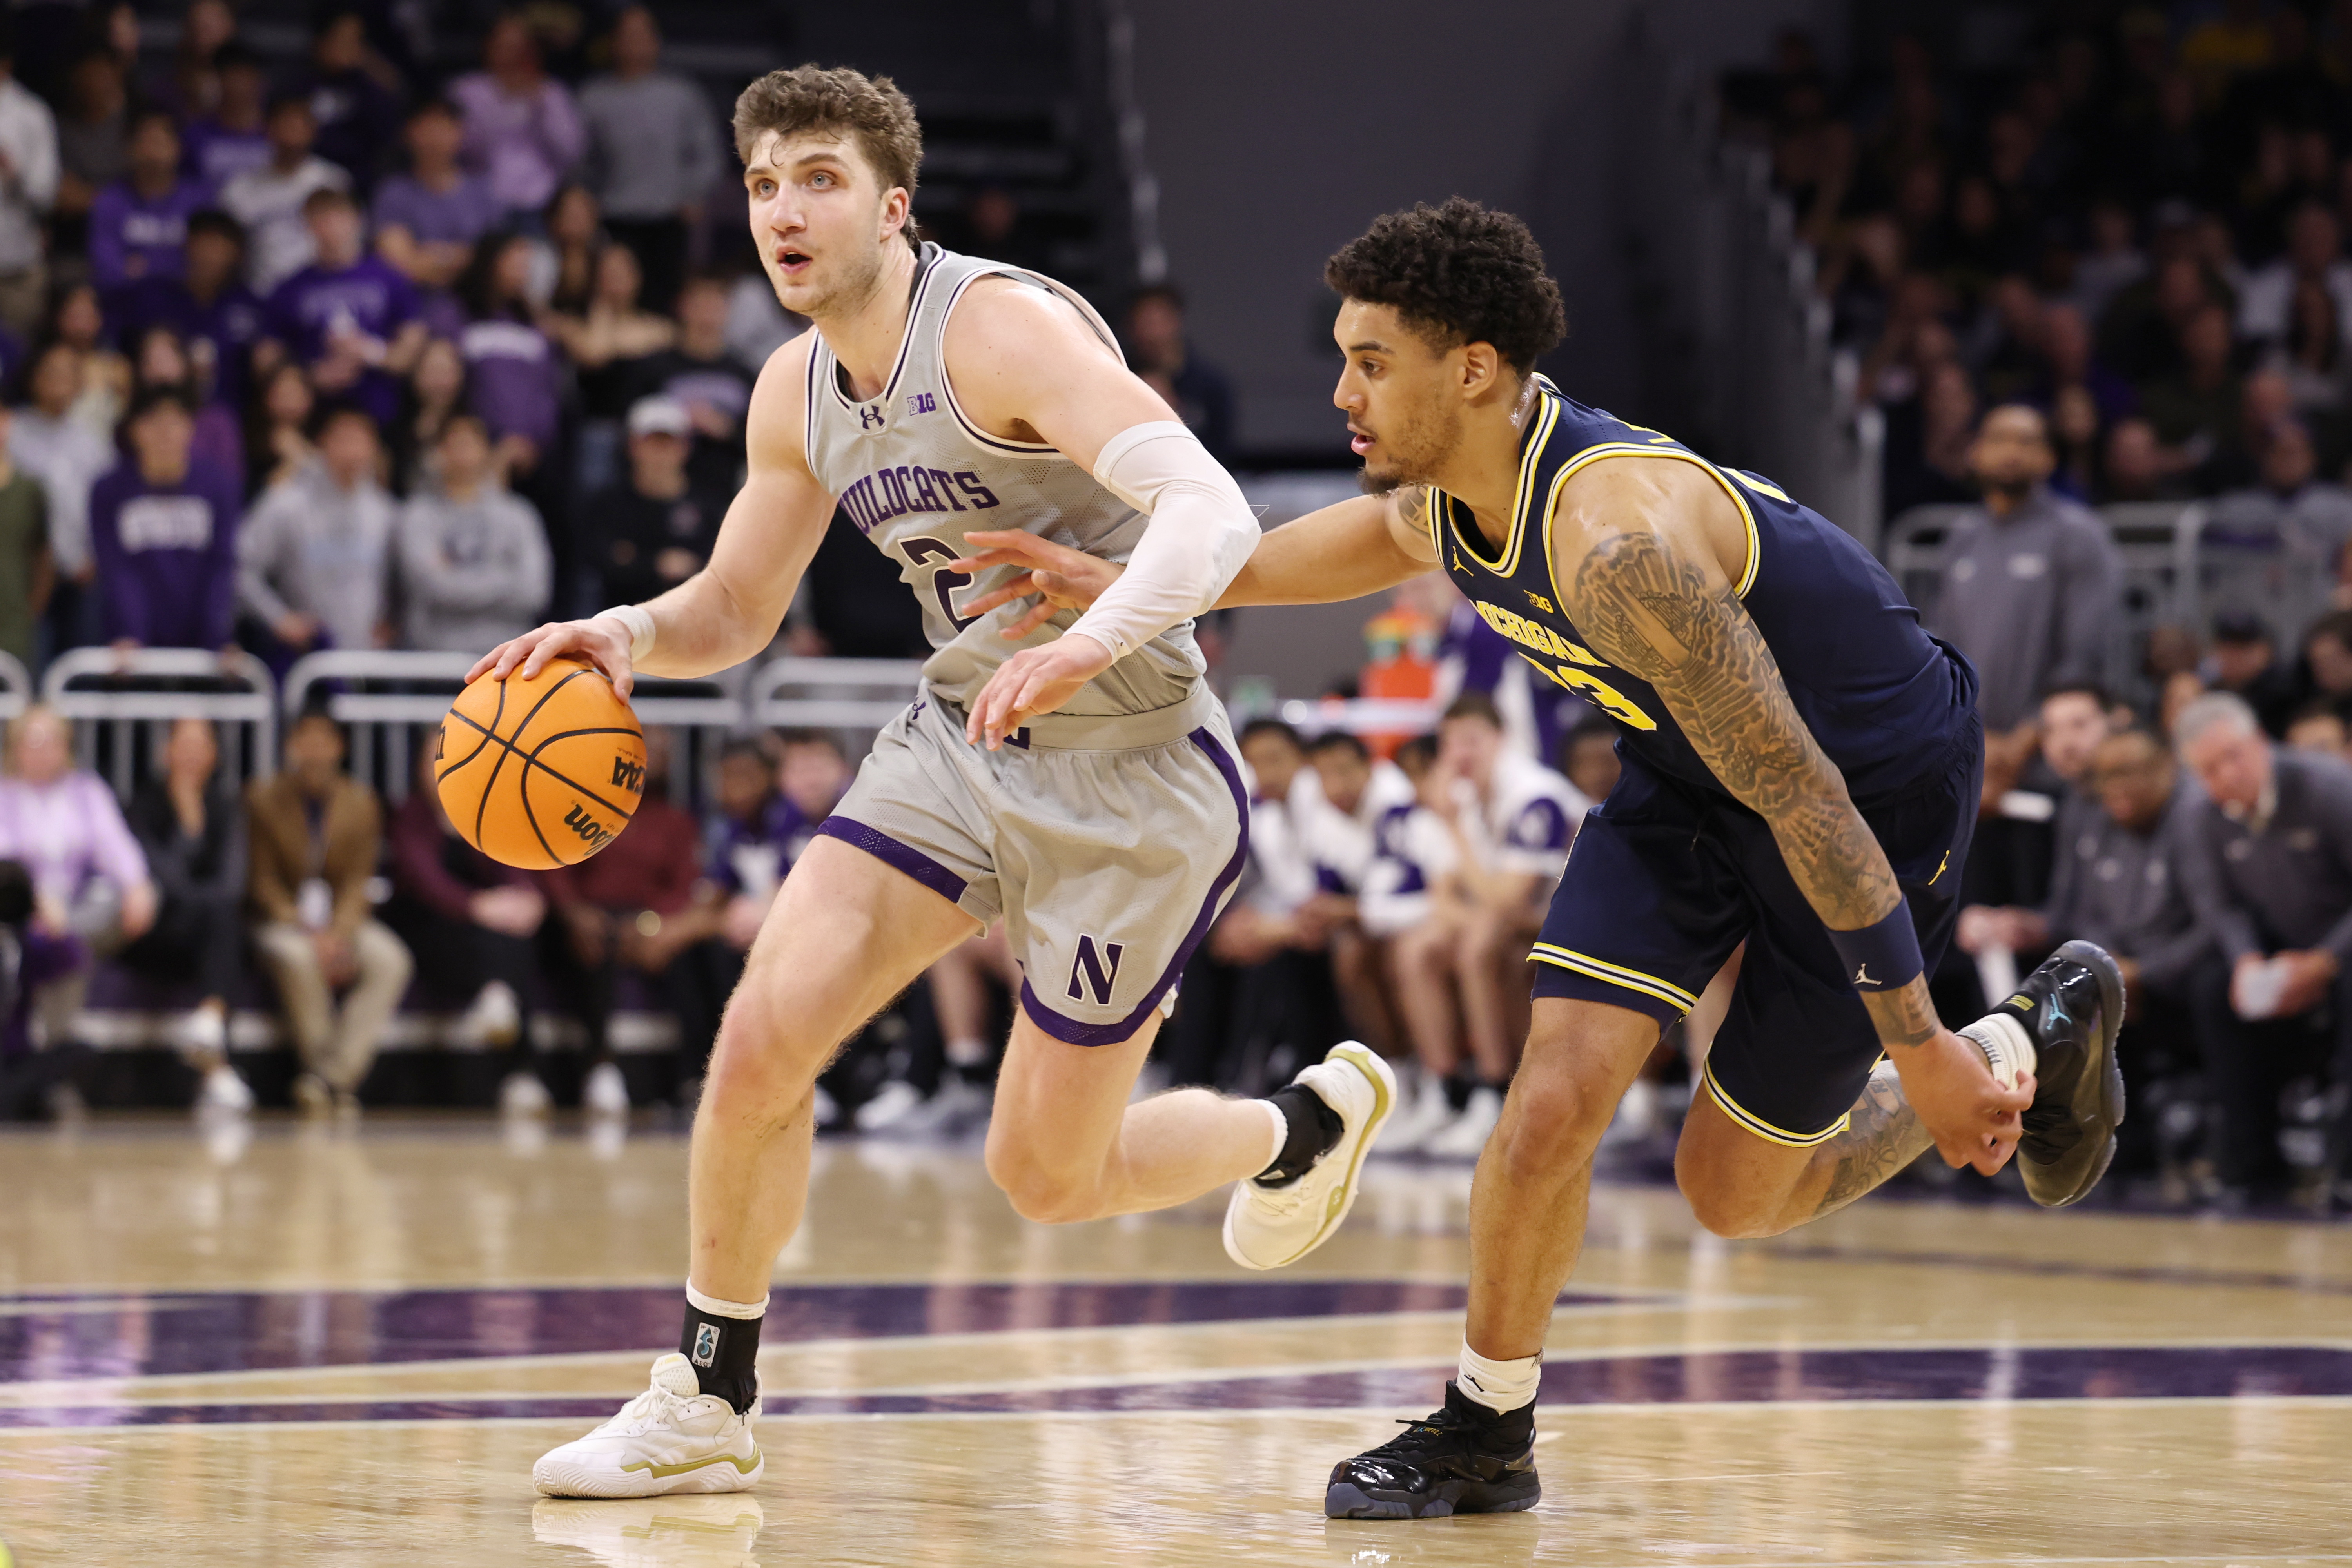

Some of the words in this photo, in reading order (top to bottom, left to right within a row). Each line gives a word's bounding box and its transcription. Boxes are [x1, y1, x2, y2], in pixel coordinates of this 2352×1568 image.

[838, 466, 1000, 536] WILDCATS
[1517, 651, 1657, 731] 3
[1065, 932, 1125, 1006] N
